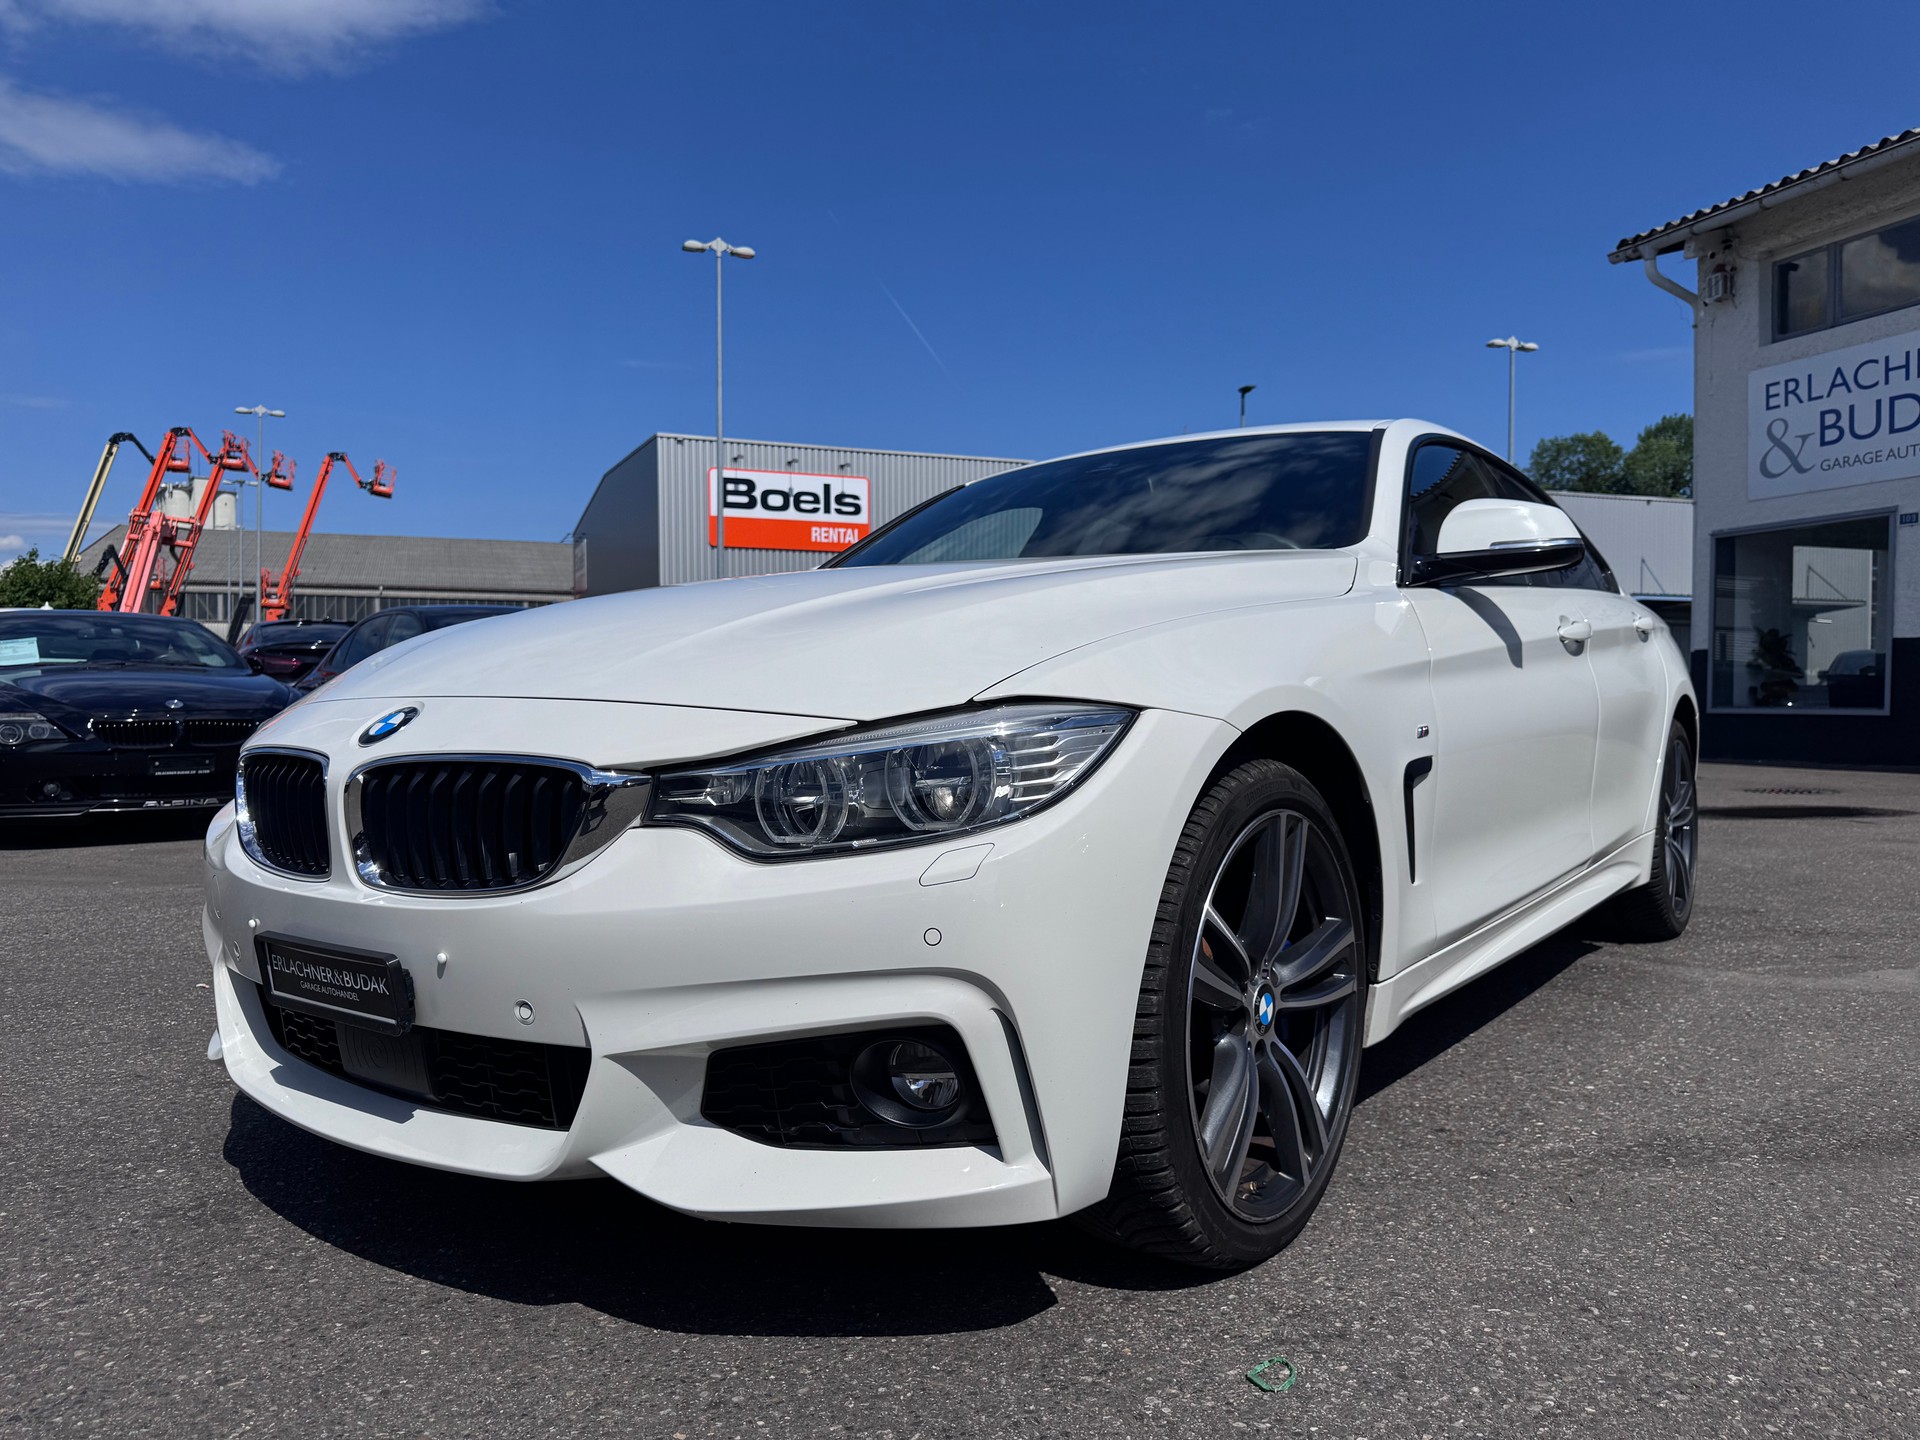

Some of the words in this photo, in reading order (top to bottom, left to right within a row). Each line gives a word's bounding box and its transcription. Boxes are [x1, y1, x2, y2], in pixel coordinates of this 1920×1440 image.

[1759, 417, 1816, 479] &
[1820, 450, 1883, 472] GARAGE
[1886, 443, 1920, 461] AUT
[722, 477, 862, 516] Boels
[810, 526, 859, 544] RENTAL
[143, 797, 219, 807] ALPINA
[271, 953, 390, 996] ERLACHNER&BUDAK
[300, 979, 322, 994] GARAGE
[321, 985, 360, 1002] AUTOHANDEL
